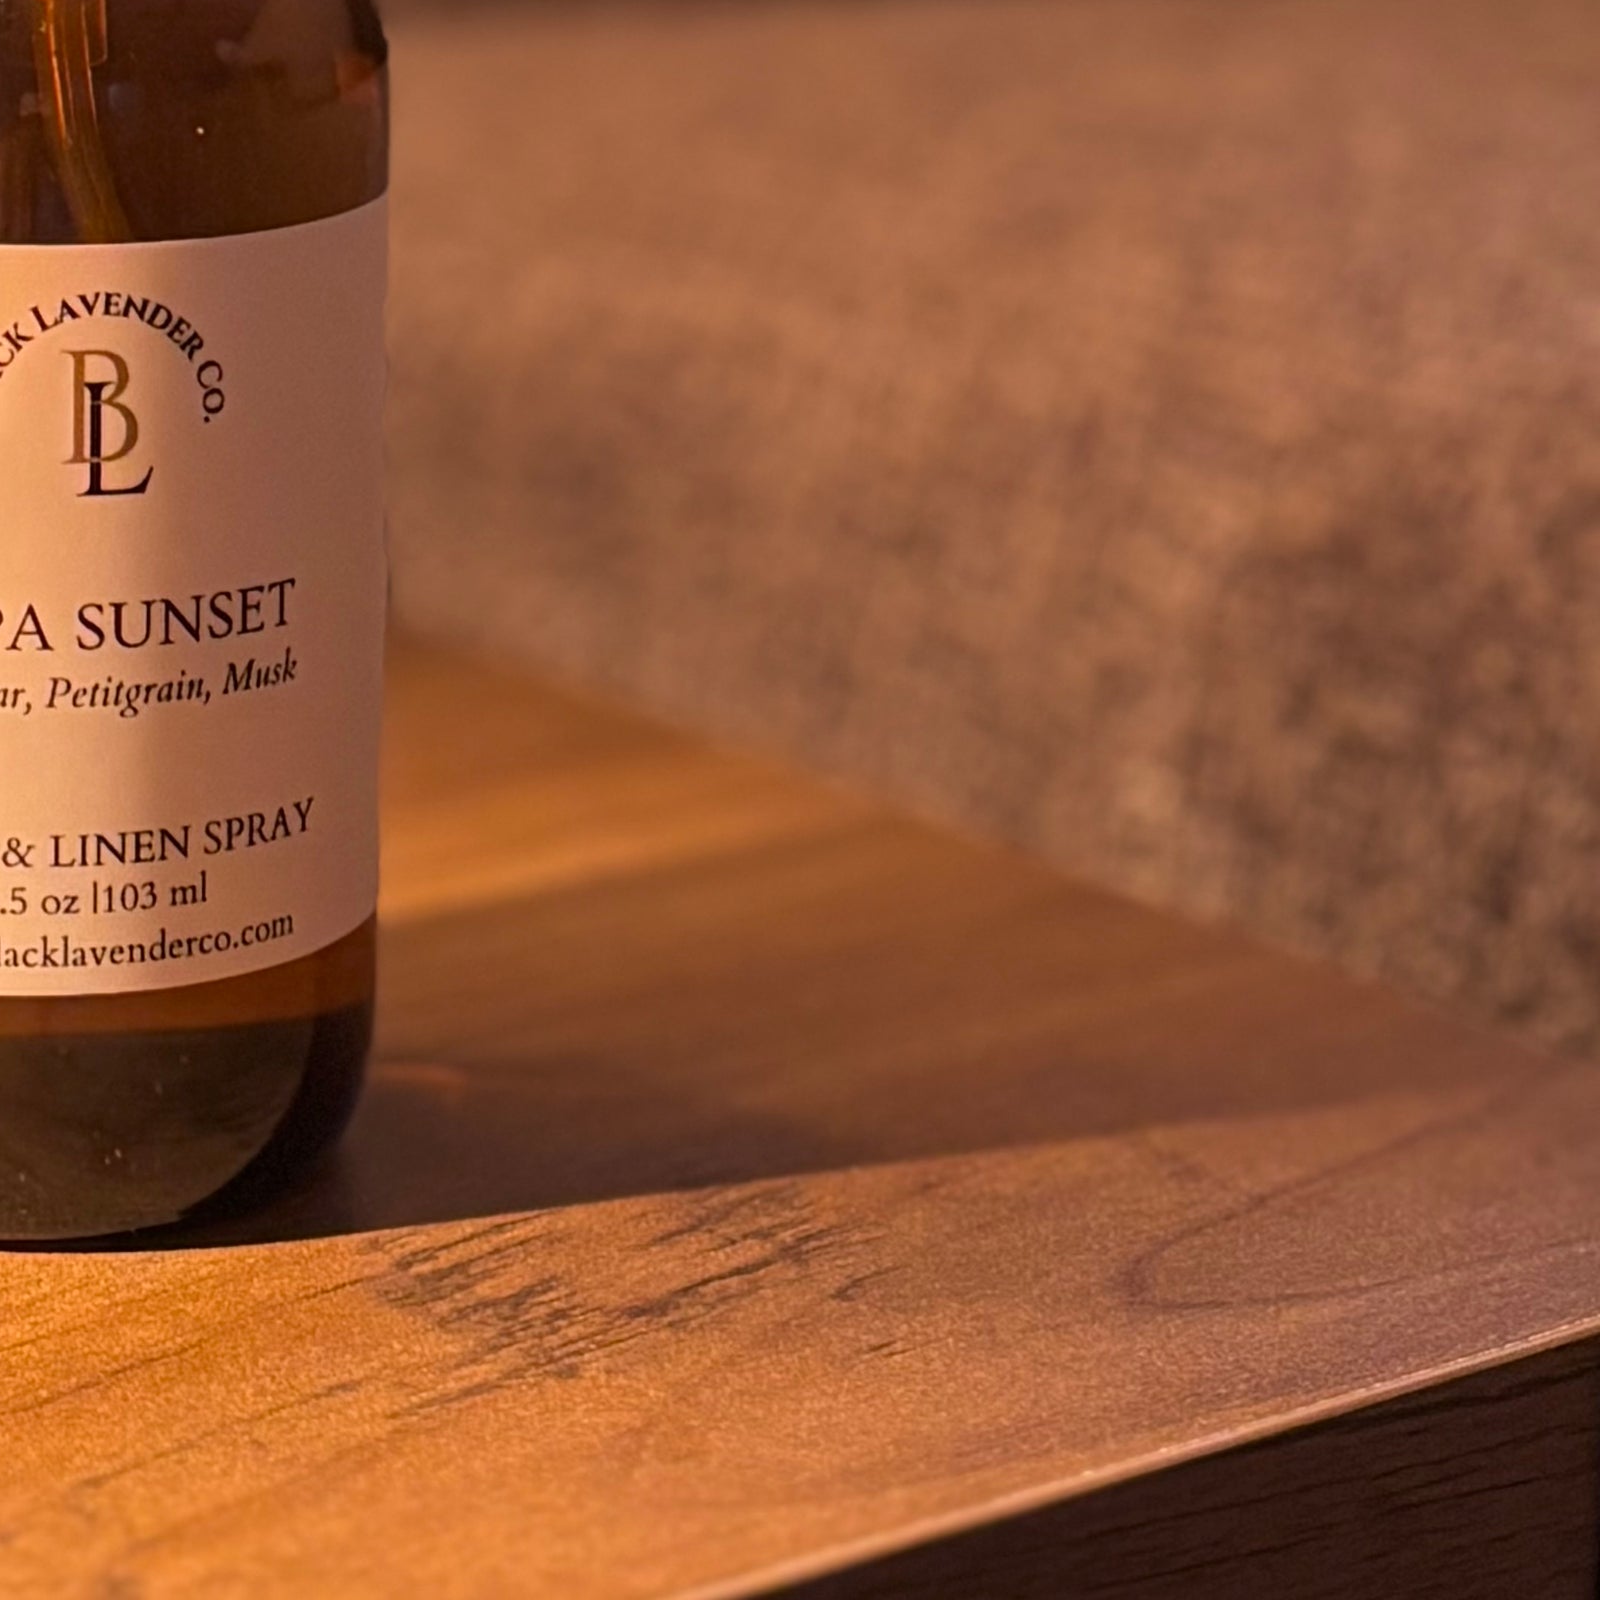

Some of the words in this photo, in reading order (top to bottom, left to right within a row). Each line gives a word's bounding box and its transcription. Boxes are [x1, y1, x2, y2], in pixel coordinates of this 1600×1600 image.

[29, 291, 204, 362] LAVENDER
[76, 577, 296, 651] SUNSET
[45, 669, 212, 718] Petitgrain,
[222, 646, 298, 695] Musk
[1, 836, 36, 868] &
[50, 825, 192, 868] LINEN
[202, 797, 315, 856] SPRAY
[41, 891, 80, 916] oz
[169, 870, 208, 906] ml
